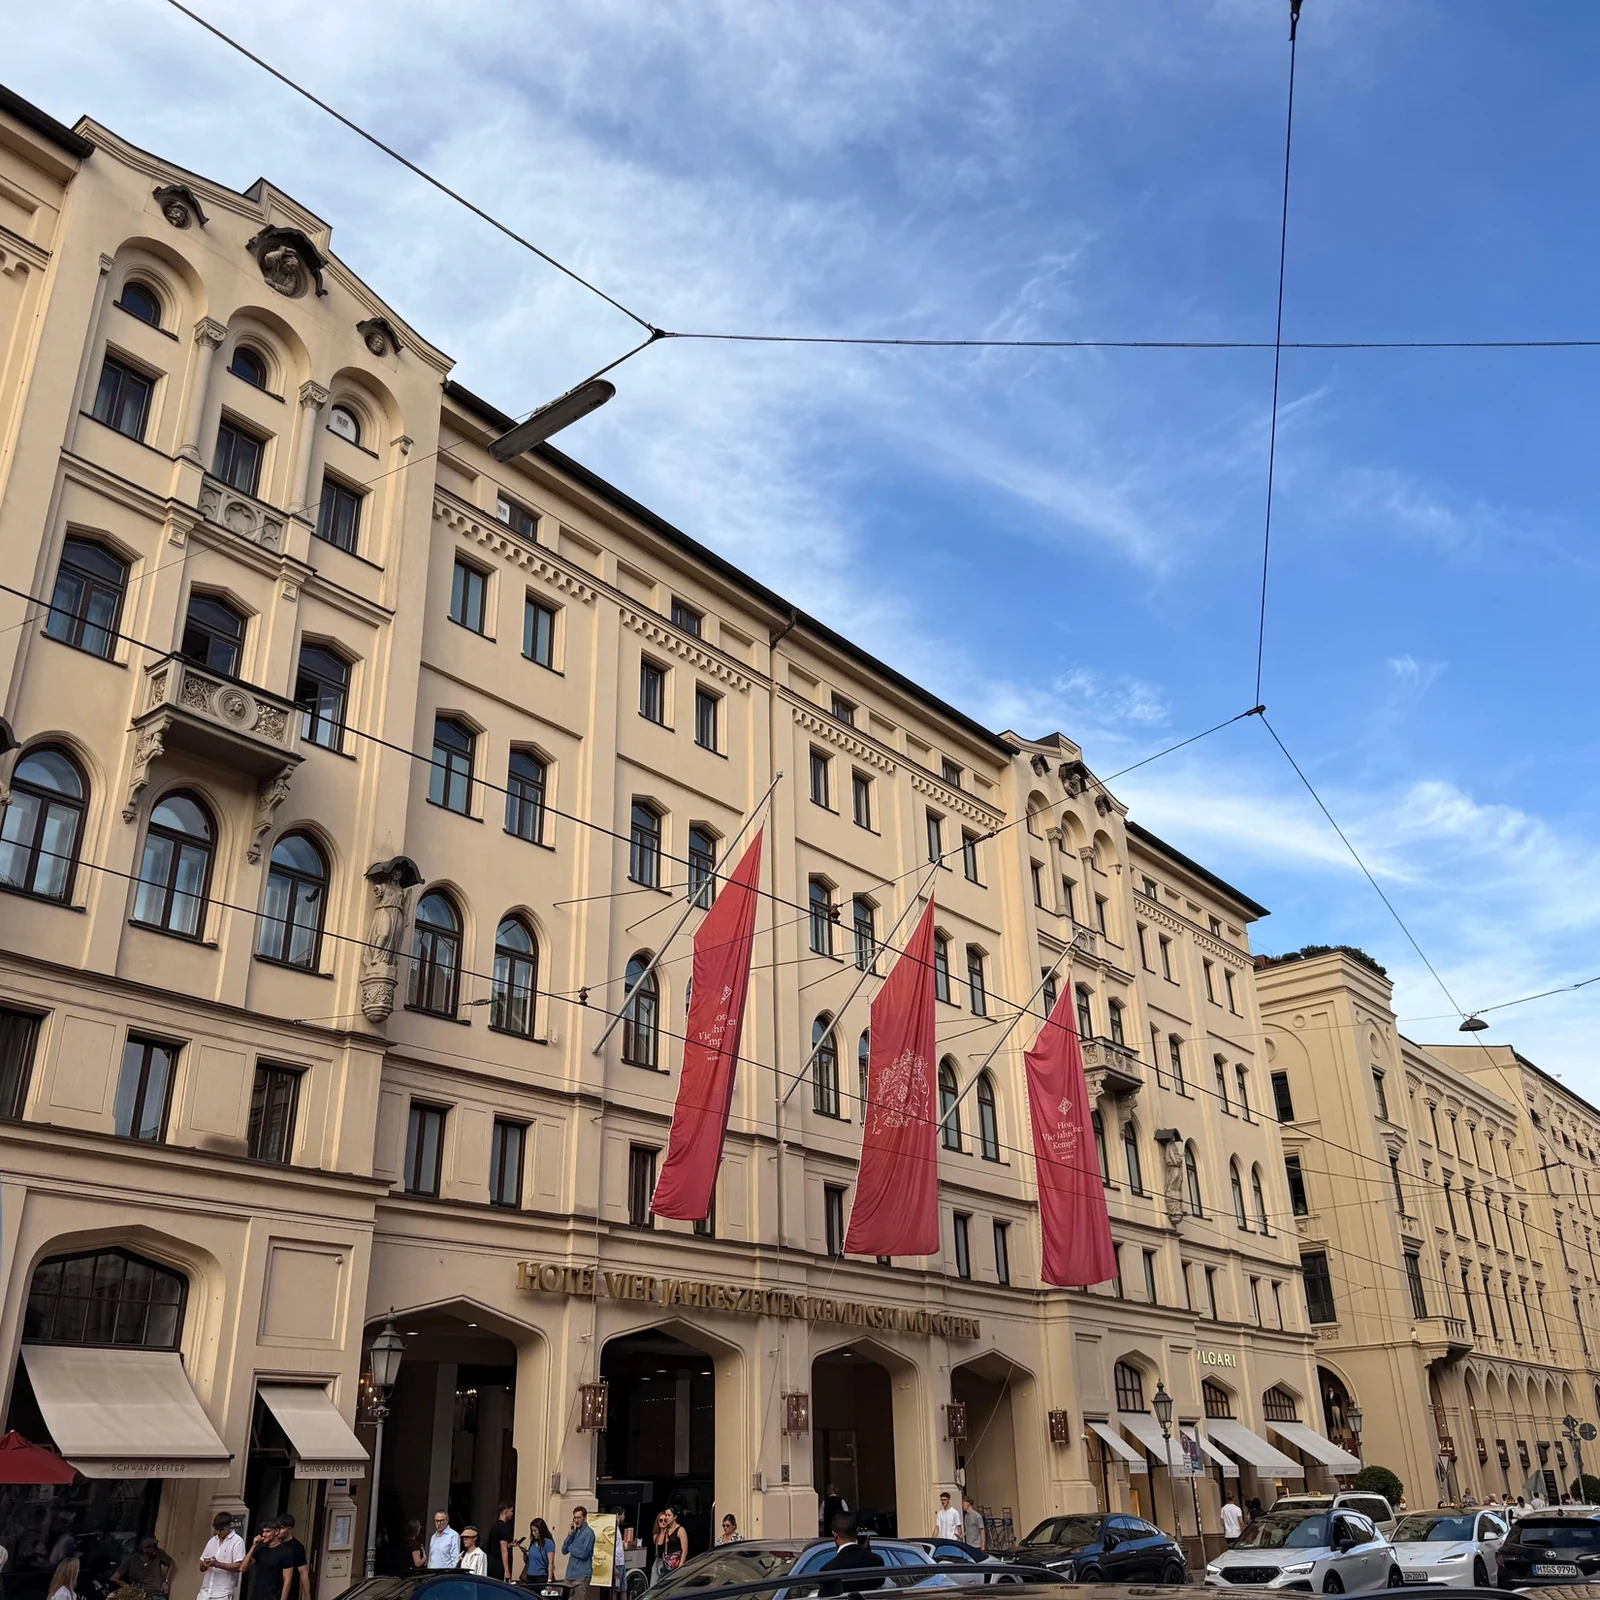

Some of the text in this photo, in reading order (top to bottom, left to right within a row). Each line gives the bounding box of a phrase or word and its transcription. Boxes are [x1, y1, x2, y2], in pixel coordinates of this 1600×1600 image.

[603, 1272, 658, 1300] VIER
[1197, 1350, 1236, 1368] LGARI
[111, 1463, 186, 1472] SCHWARZREITER
[299, 1465, 361, 1473] SCHWARZREITER
[1557, 1565, 1576, 1574] 9796
